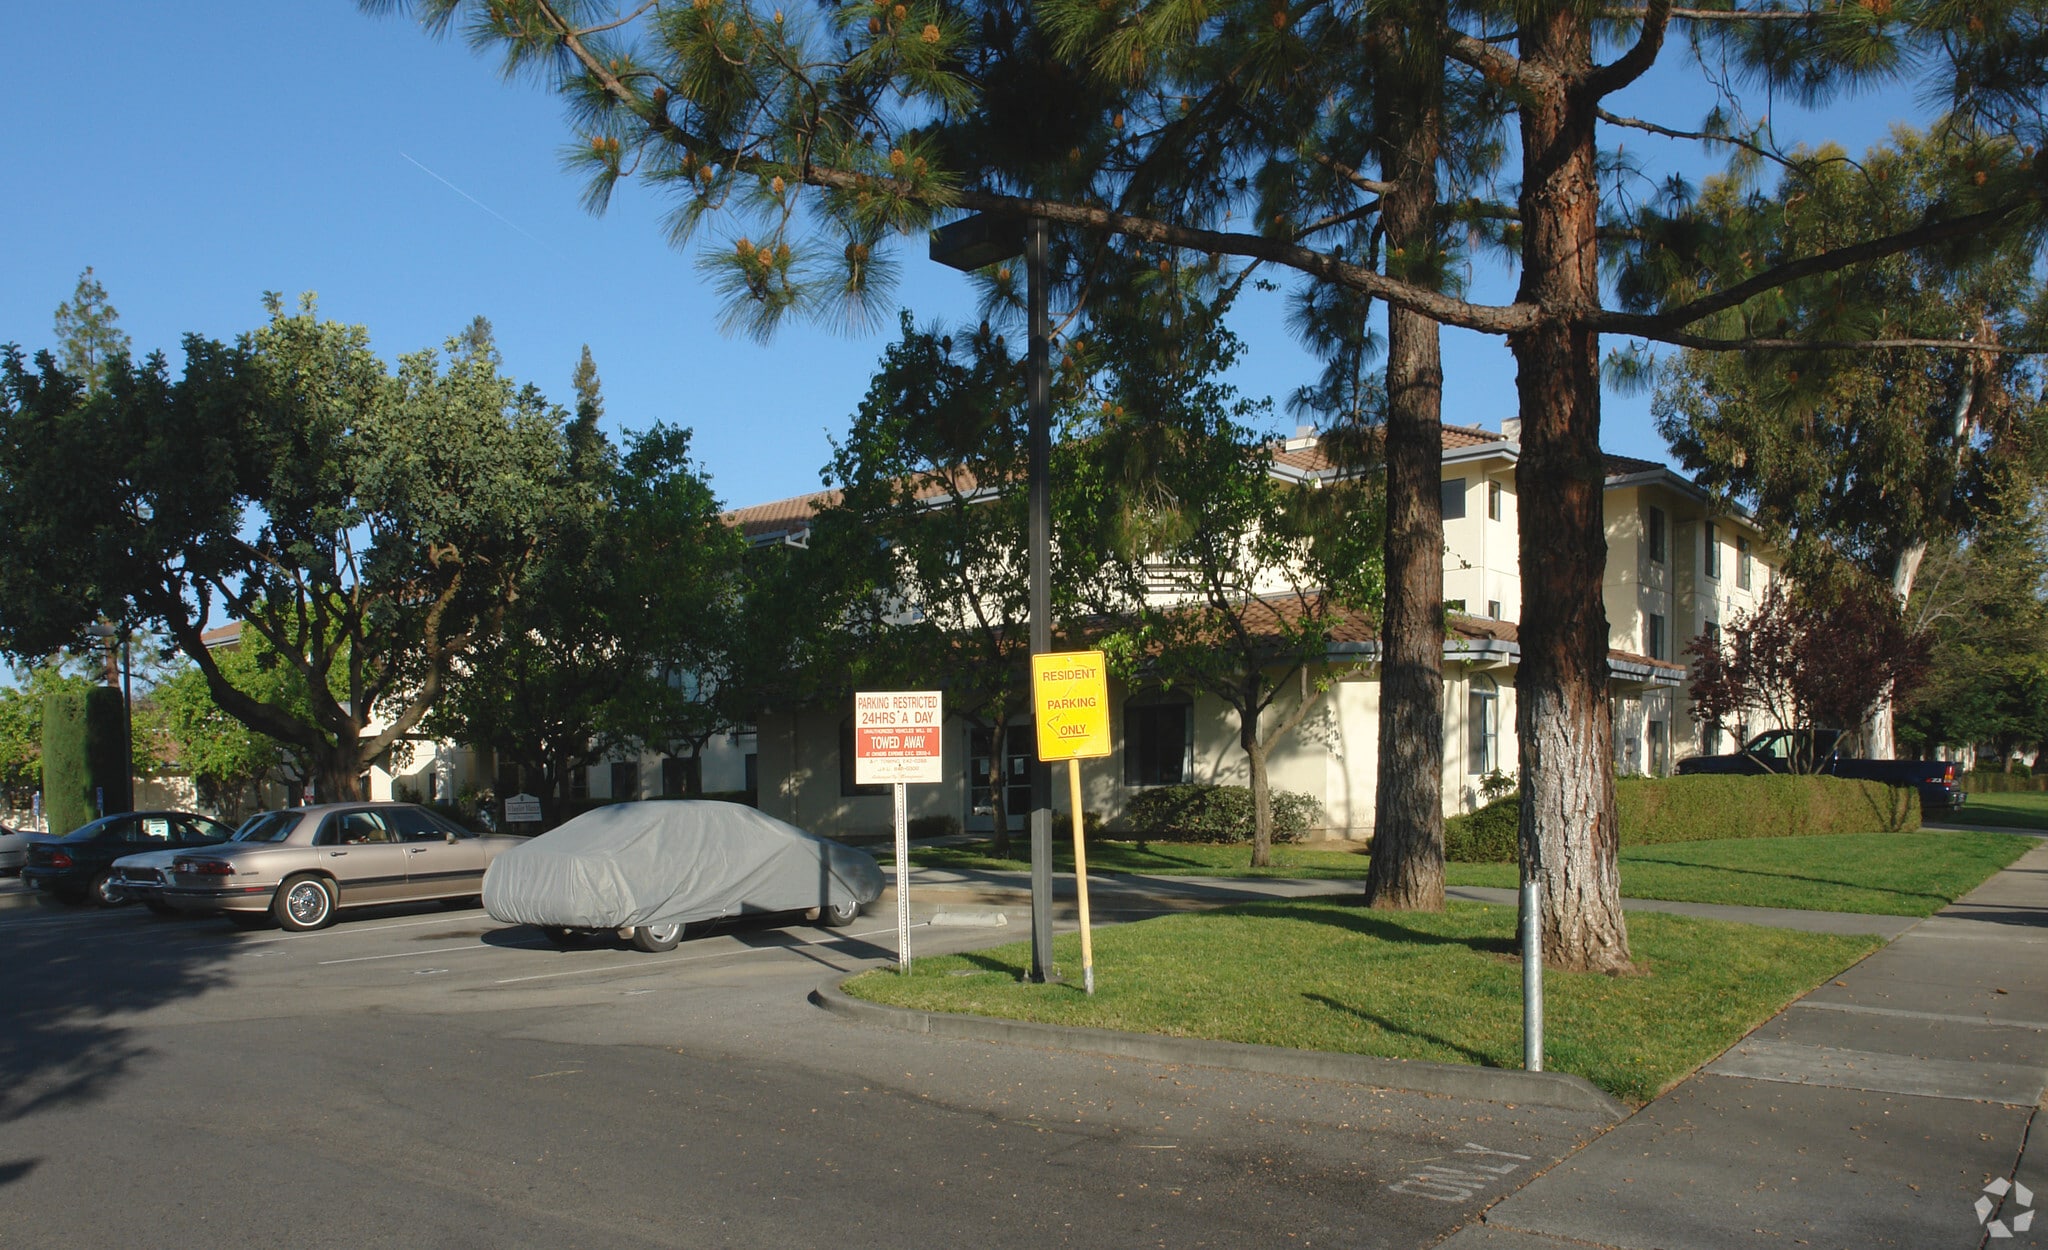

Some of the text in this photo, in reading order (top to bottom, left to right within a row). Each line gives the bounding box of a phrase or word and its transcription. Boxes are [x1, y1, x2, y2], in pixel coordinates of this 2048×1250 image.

[1043, 669, 1096, 681] RESIDENT
[858, 696, 937, 709] PARKING RESTRICTED
[1047, 697, 1096, 710] PARKING
[862, 711, 933, 724] 24HRS A DAY
[1060, 724, 1086, 735] ONLY
[871, 736, 925, 749] TOWED AWAY
